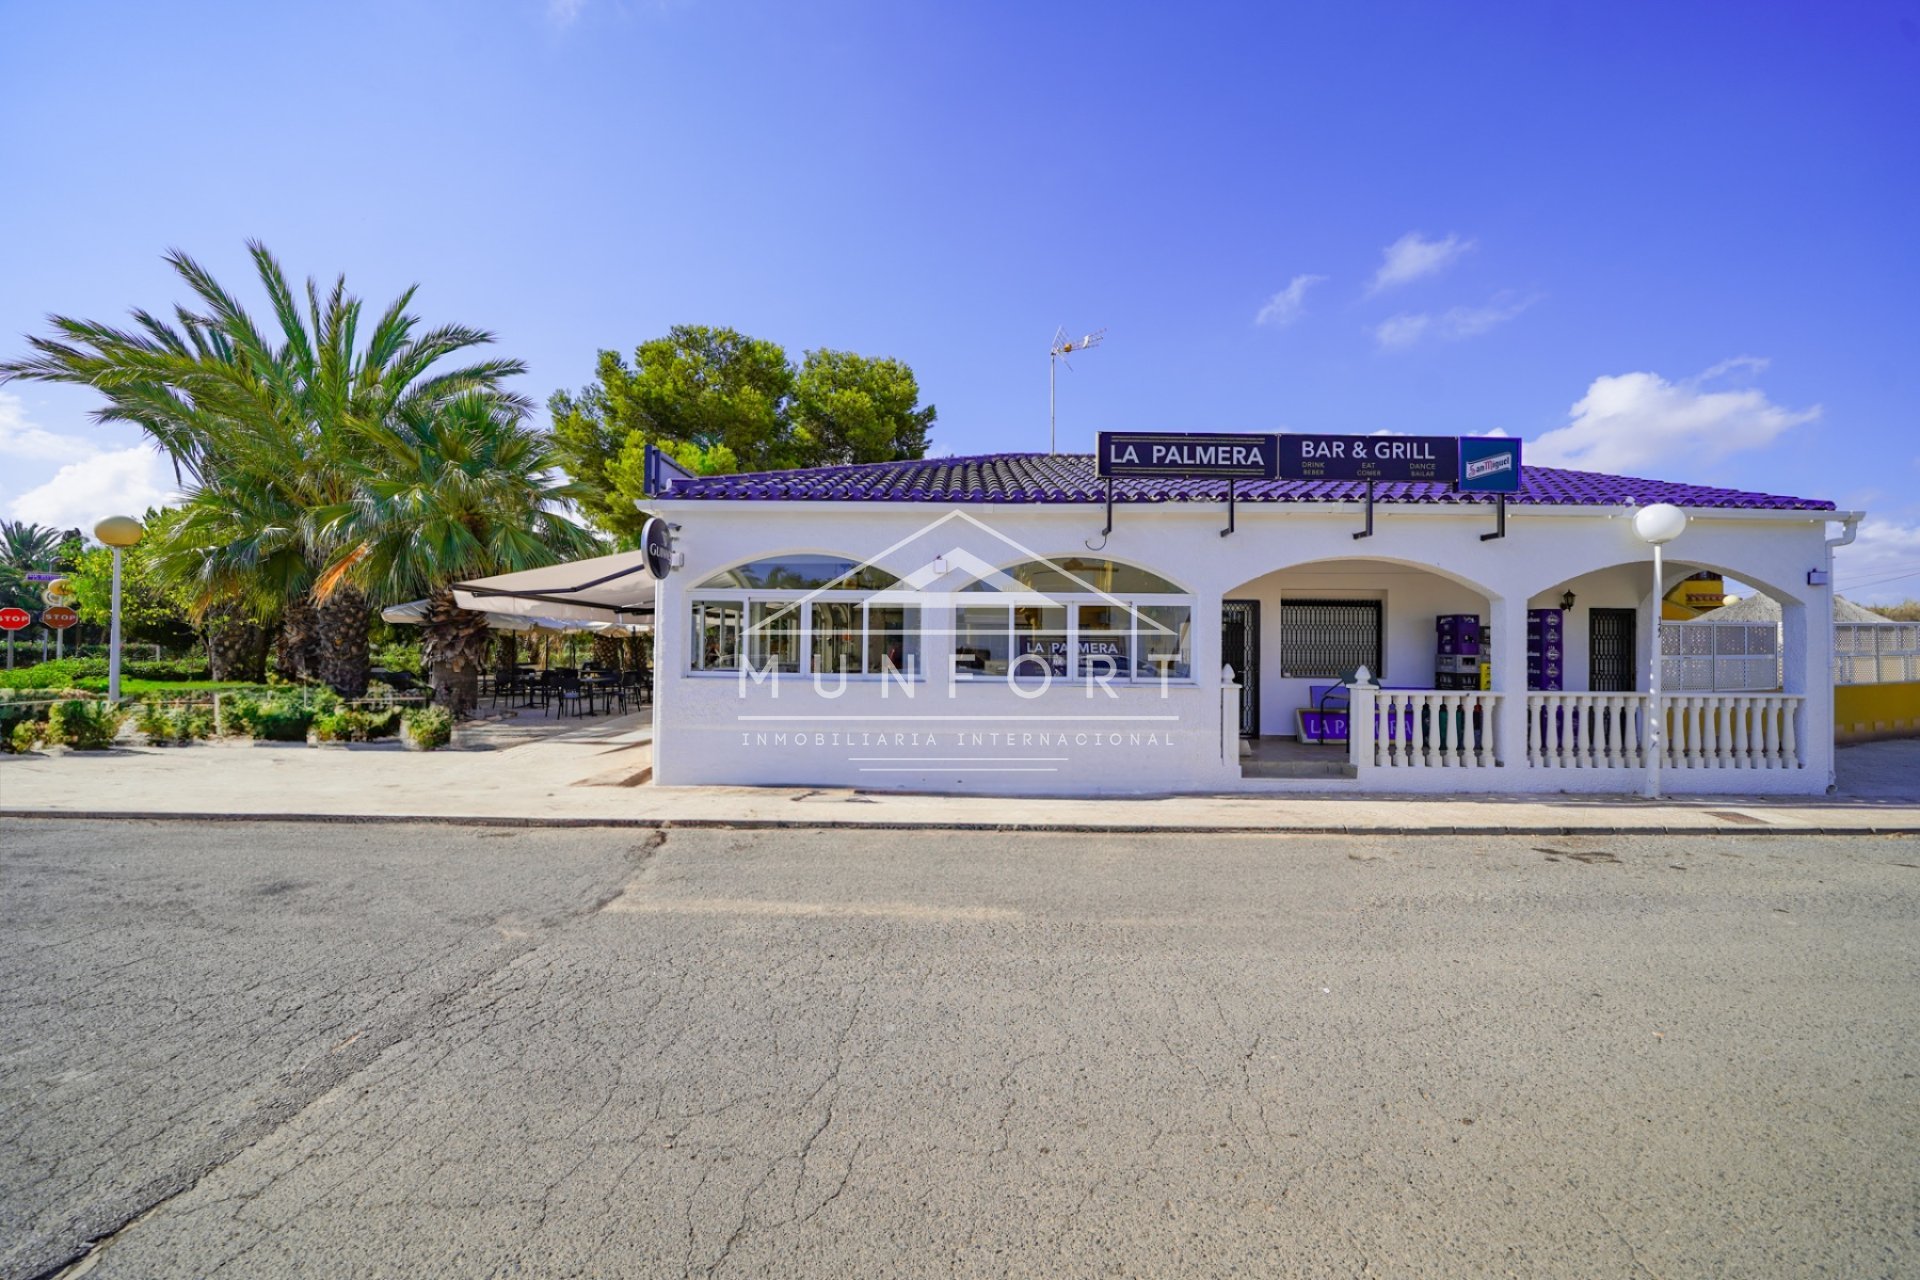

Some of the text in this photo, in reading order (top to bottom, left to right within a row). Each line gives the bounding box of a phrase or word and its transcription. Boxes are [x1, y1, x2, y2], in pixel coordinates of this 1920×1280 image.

[1110, 444, 1265, 465] LA PALMERA
[1302, 441, 1436, 459] BAR & GRILL
[1027, 642, 1118, 654] LA PAMERA
